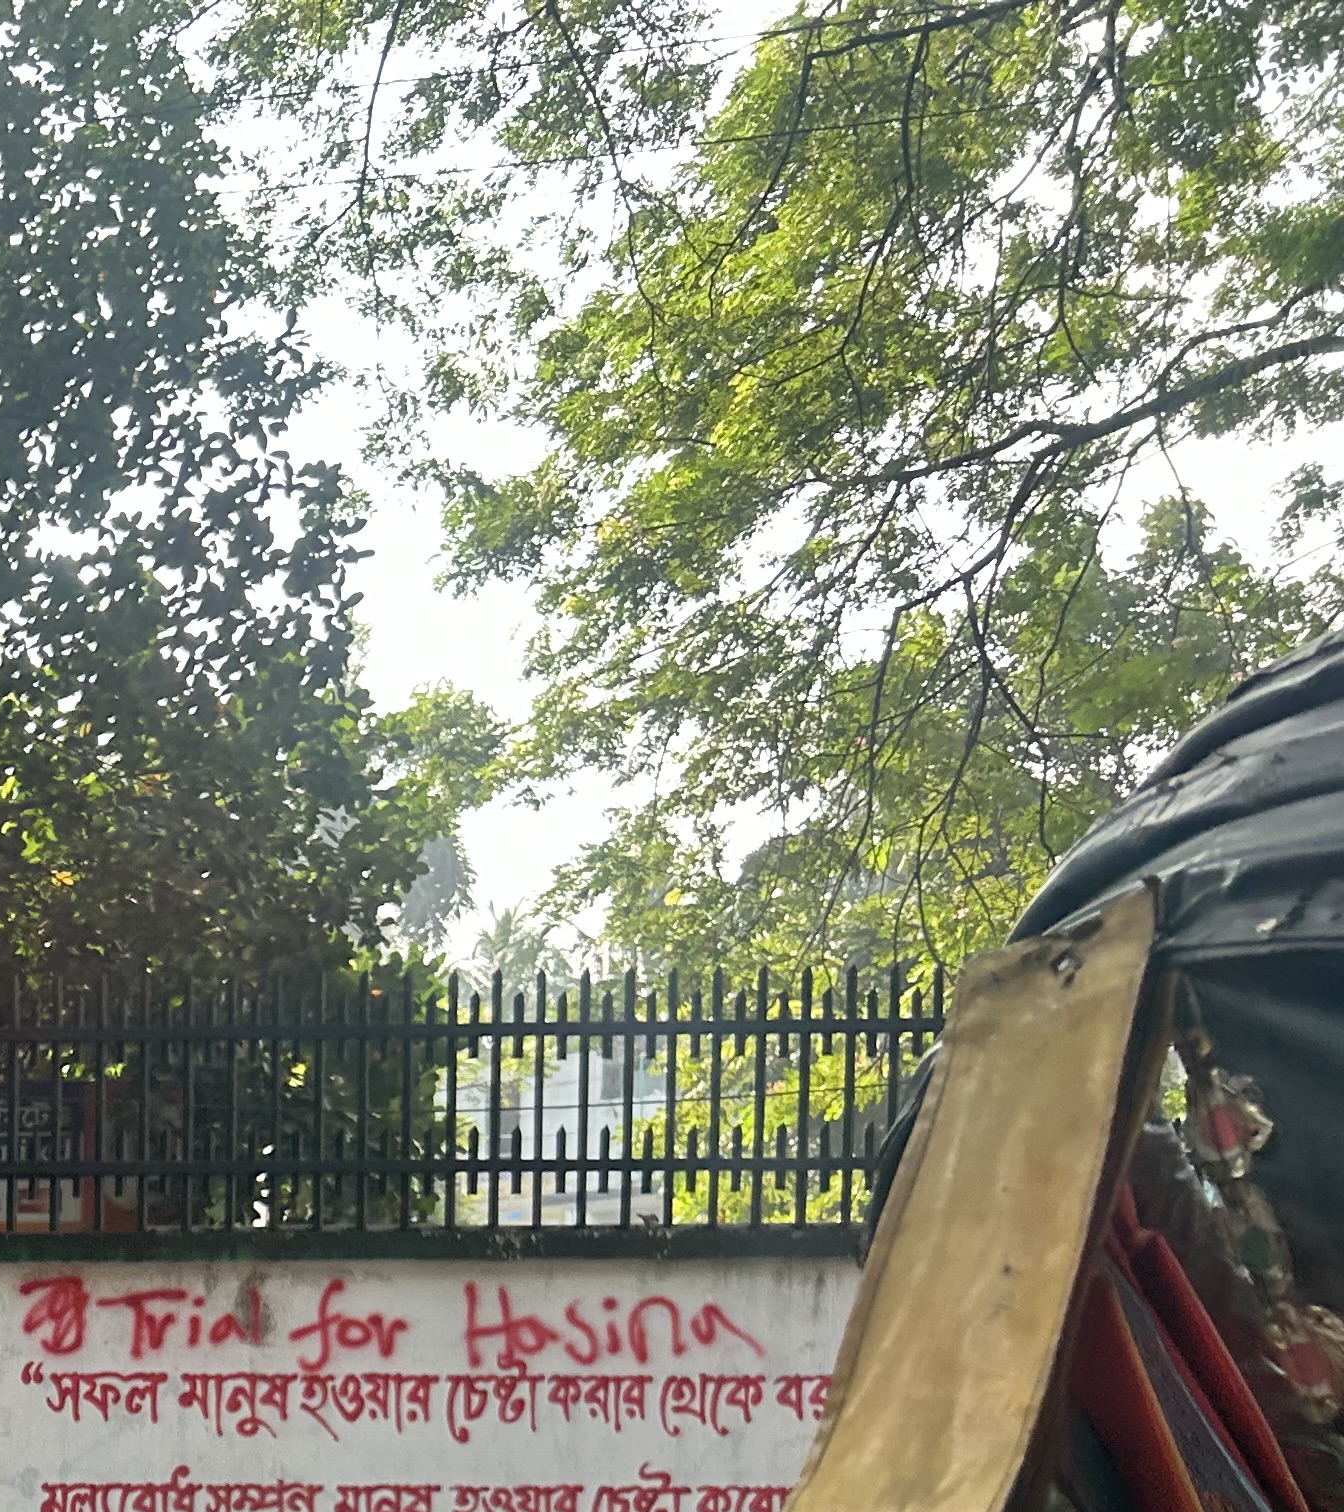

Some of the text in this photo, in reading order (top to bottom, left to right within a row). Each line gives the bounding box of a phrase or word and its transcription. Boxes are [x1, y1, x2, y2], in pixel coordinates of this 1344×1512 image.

[96, 1289, 261, 1359] Trial
[288, 1279, 408, 1372] for
[463, 1281, 765, 1367] Hasina
[178, 1372, 298, 1438] মানুষ
[299, 1373, 439, 1442] হওয়ার
[447, 1359, 544, 1444] চেষ্টা
[548, 1374, 653, 1432] করার
[661, 1374, 765, 1436] থেকে
[775, 1374, 832, 1421] বর
